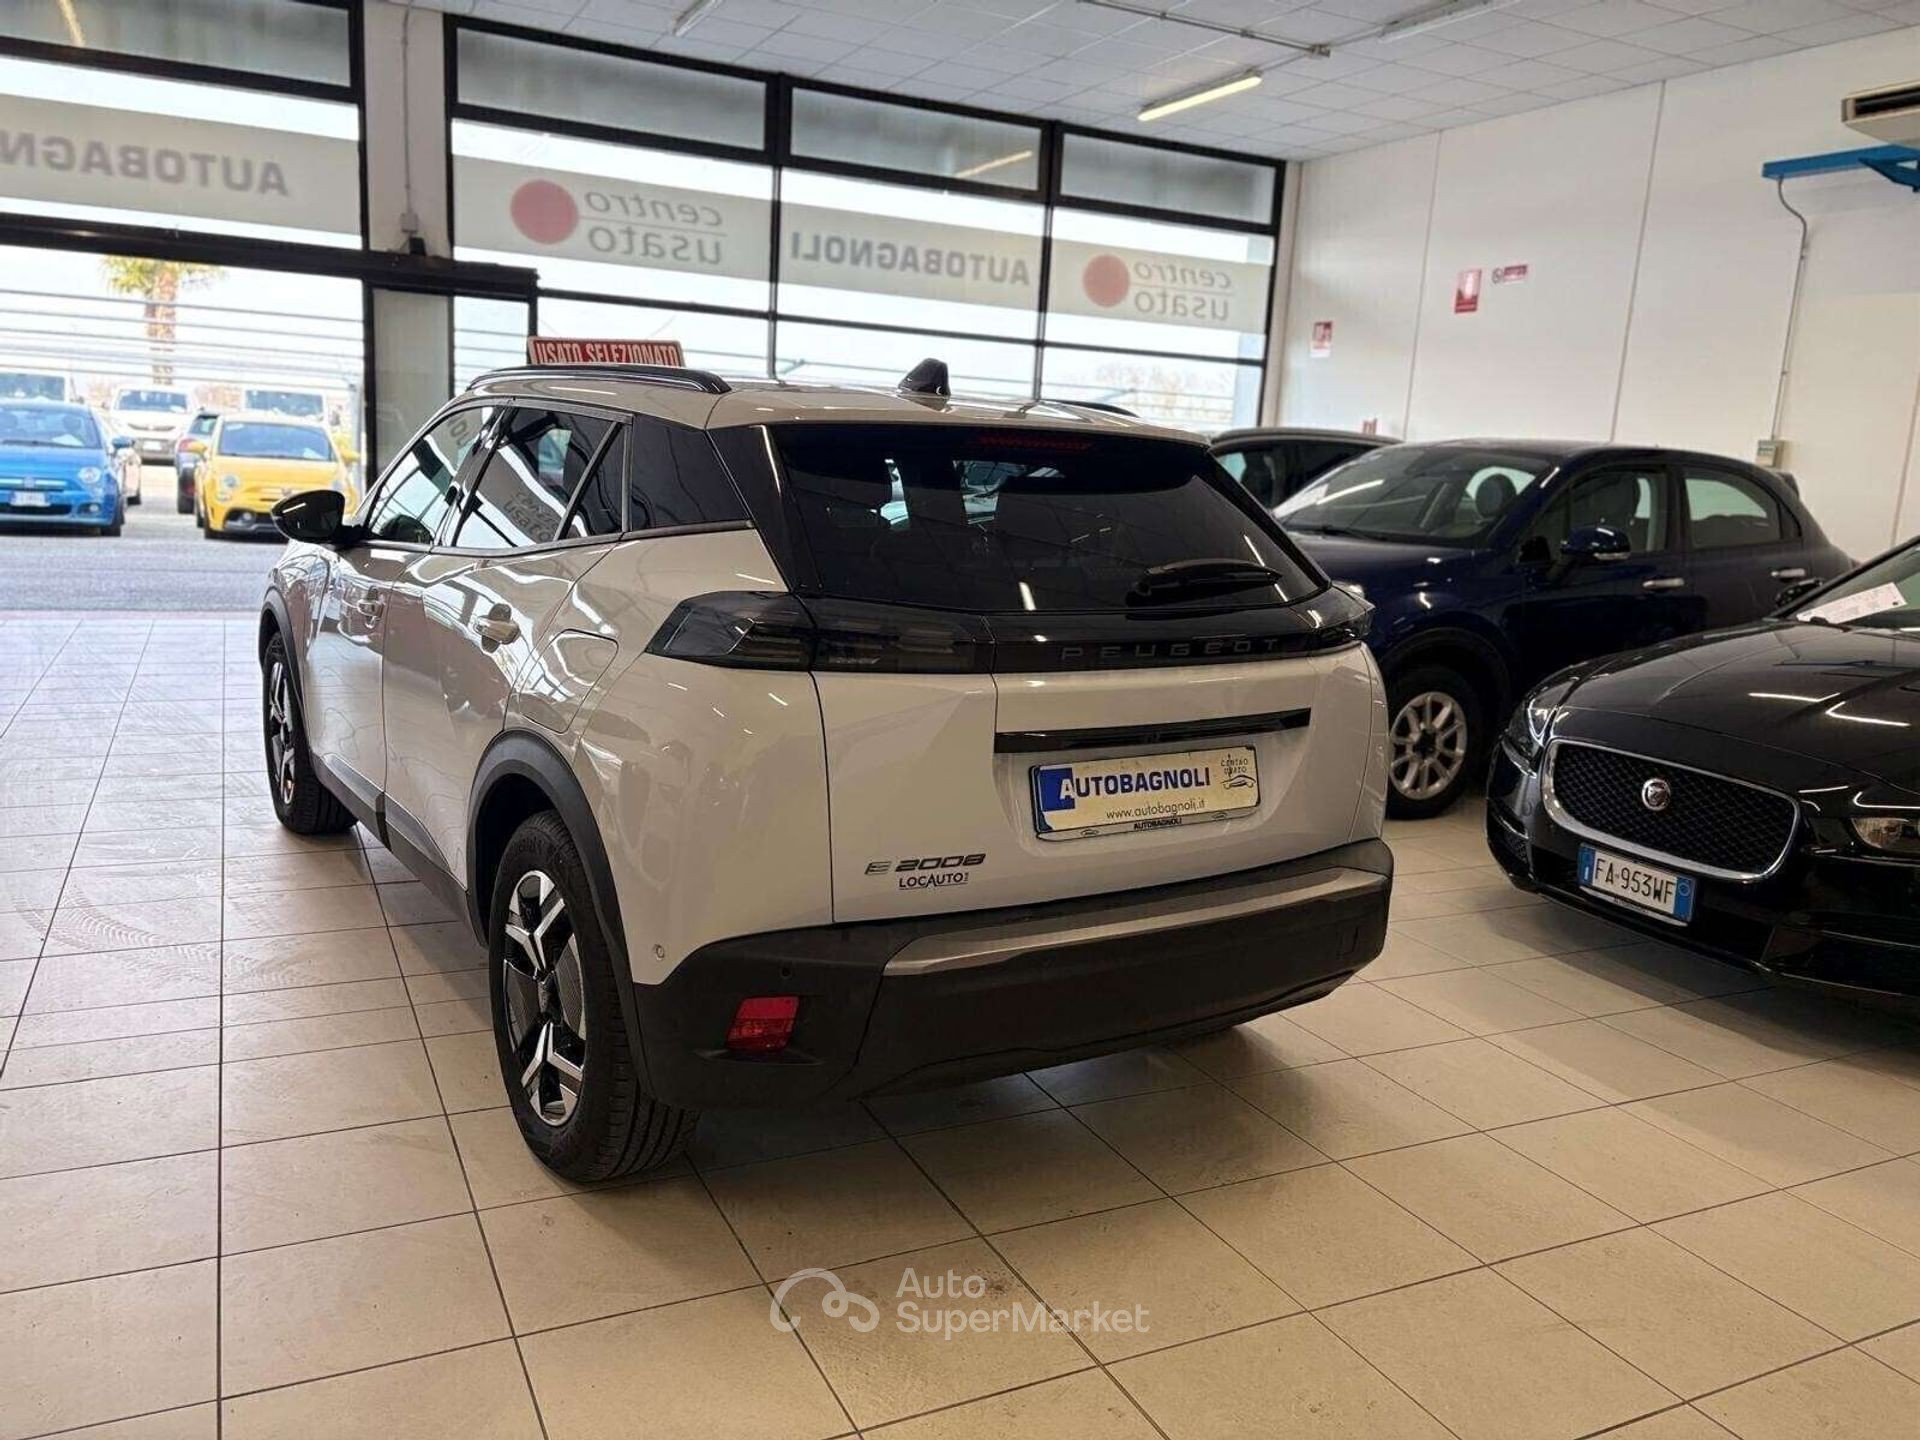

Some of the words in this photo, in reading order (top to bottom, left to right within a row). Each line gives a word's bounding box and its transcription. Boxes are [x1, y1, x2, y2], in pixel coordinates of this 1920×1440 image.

[536, 342, 583, 365] USATO
[585, 342, 681, 368] SELEZIONATO
[1061, 638, 1279, 660] PEUGEOT
[1059, 767, 1211, 800] AUTOBAGNOLI
[1106, 797, 1206, 819] www.autobagnoli.it
[895, 853, 986, 872] 2008
